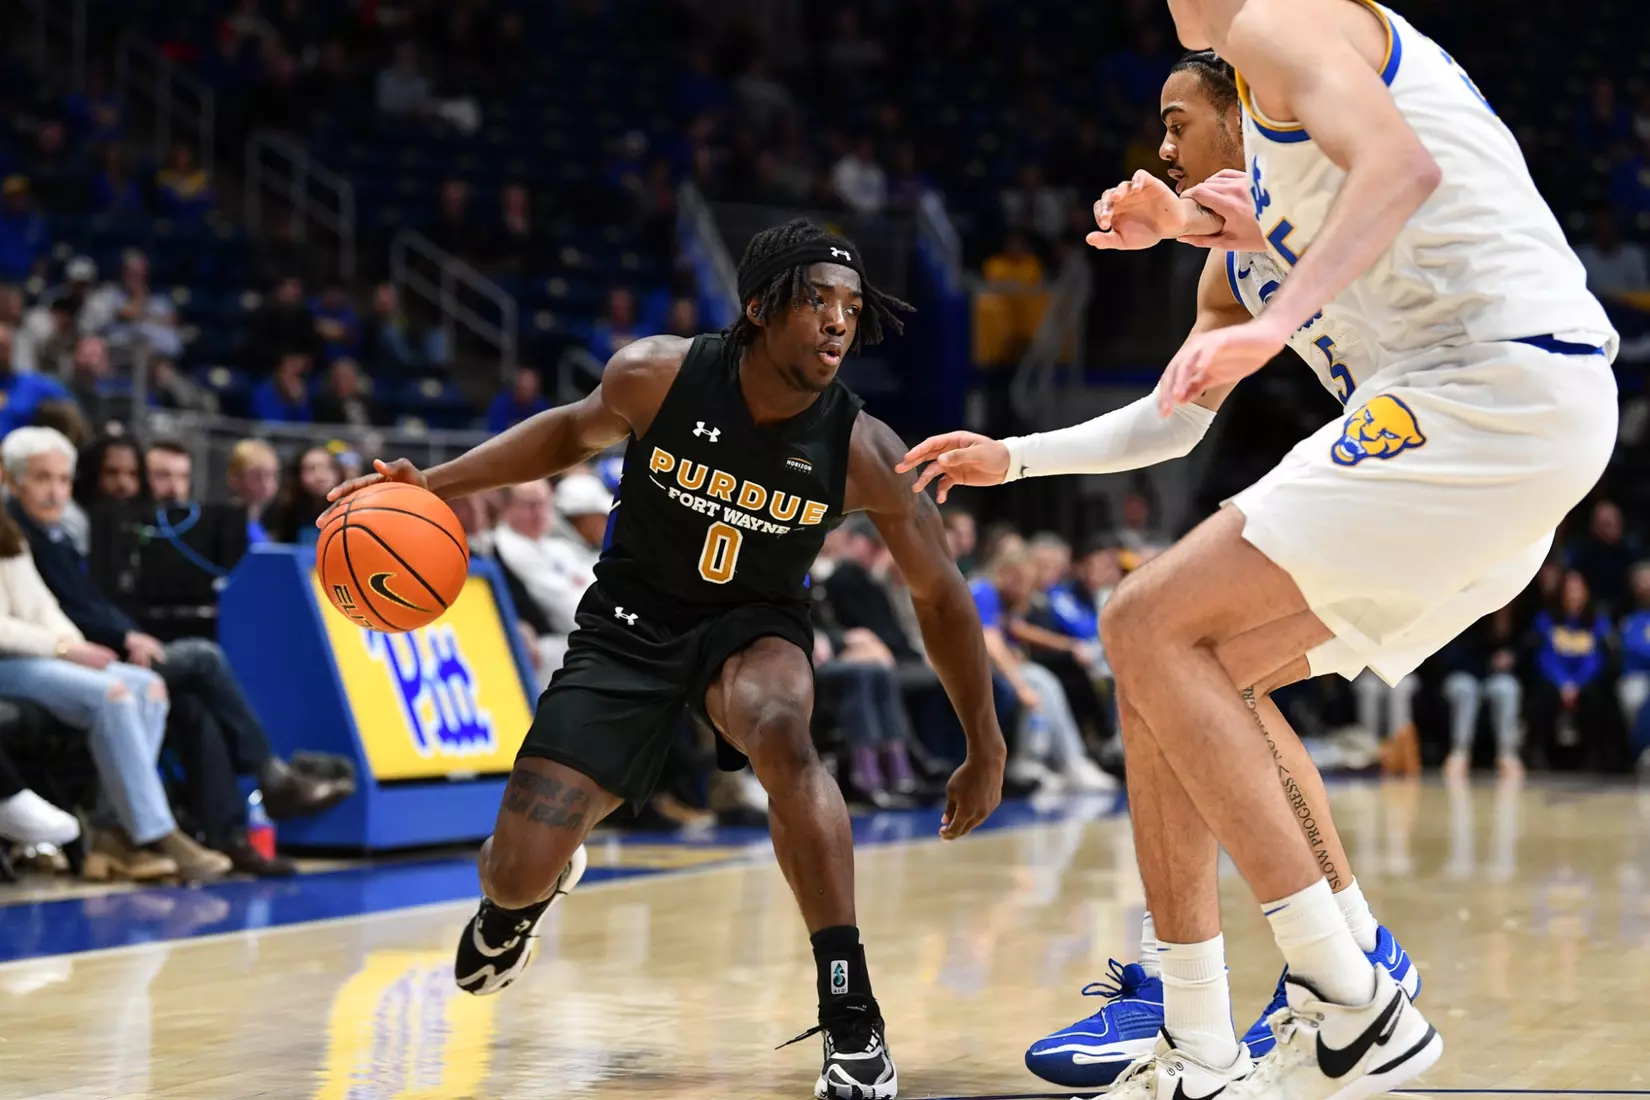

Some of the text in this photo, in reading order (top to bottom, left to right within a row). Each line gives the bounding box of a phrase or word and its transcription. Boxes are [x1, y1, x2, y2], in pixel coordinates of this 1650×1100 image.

[1311, 333, 1358, 407] 5
[650, 446, 829, 525] PURDUE
[668, 487, 791, 535] FORT WAYNE
[698, 520, 743, 584] 0
[333, 584, 379, 632] ELIT
[1283, 777, 1323, 847] PROGRESS
[1316, 849, 1341, 889] SLOW
